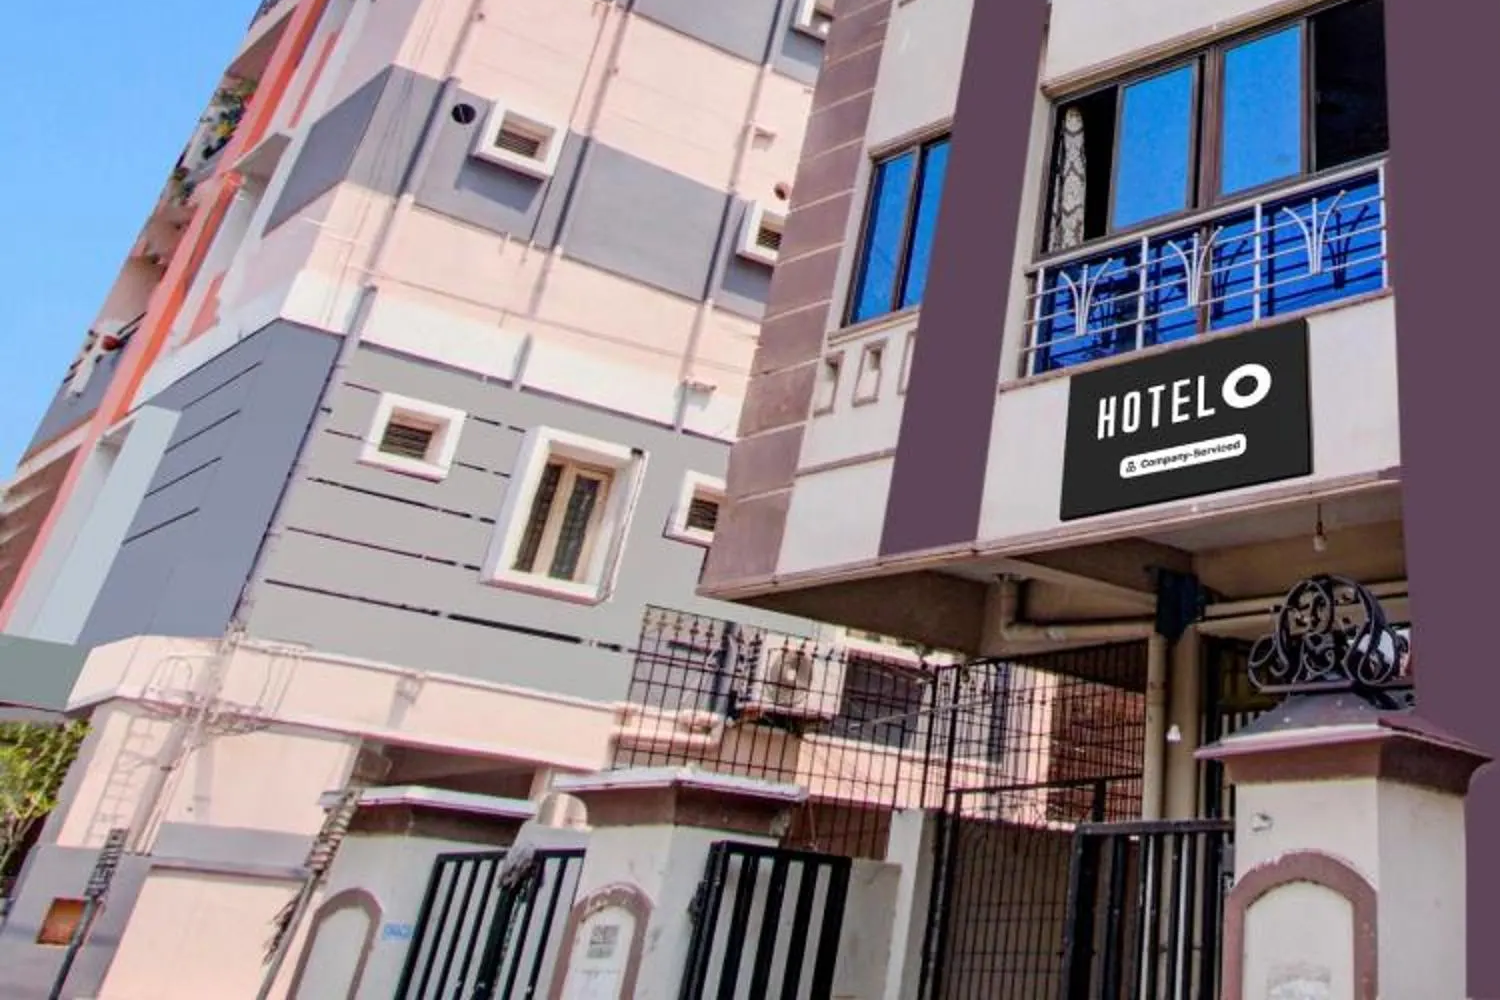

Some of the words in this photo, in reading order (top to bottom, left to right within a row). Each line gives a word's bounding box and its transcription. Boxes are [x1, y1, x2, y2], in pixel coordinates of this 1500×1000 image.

[1097, 375, 1216, 440] HOTEL
[1221, 363, 1272, 409] O
[1140, 440, 1241, 469] Company-Serviced
